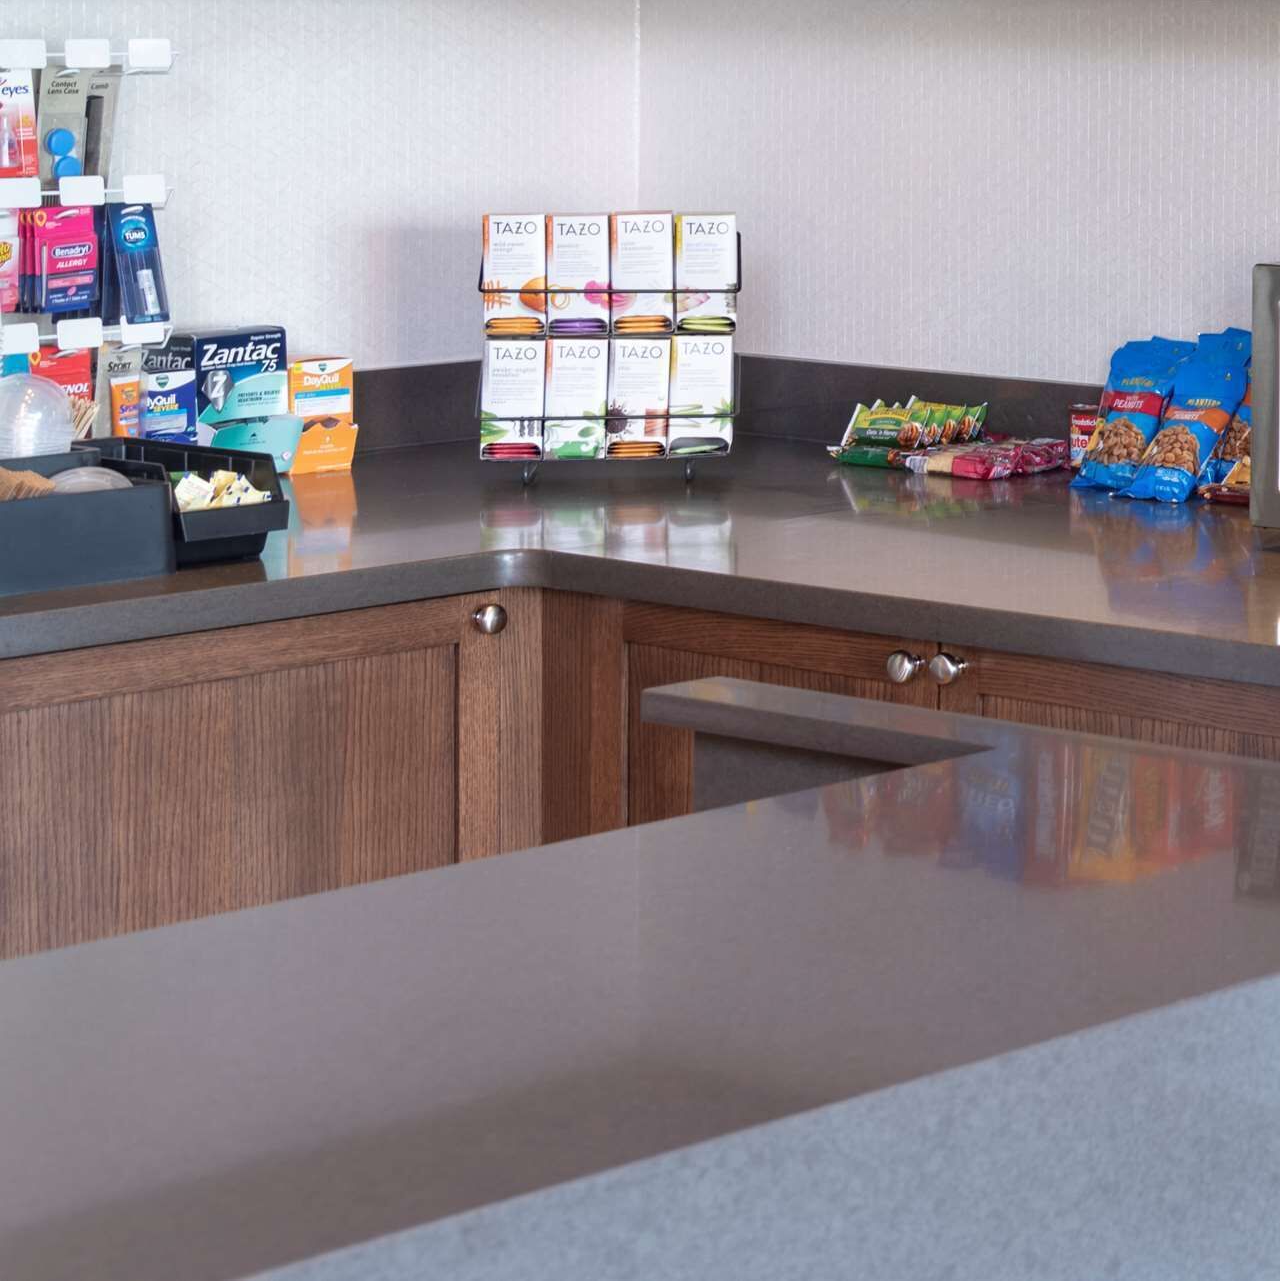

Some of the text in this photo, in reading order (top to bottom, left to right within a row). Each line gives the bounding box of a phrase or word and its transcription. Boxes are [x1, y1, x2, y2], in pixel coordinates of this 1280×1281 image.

[51, 80, 77, 88] Contact
[2, 85, 29, 98] eyes
[493, 221, 537, 235] TAZO
[557, 222, 601, 236] TAZO
[621, 220, 665, 234] TAZO
[686, 221, 730, 235] TAZO
[124, 230, 146, 241] TUMS
[55, 245, 90, 257] Benadryl
[56, 258, 88, 269] ALLERGY
[201, 341, 281, 367] Zantac
[493, 346, 537, 360] TAZO
[557, 345, 601, 360] TAZO
[620, 345, 664, 360] TAZO
[682, 342, 725, 356] TAZO
[141, 347, 191, 370] Zantac
[108, 361, 131, 372] SPORT
[261, 359, 279, 373] 75
[211, 374, 227, 399] Z
[303, 374, 340, 388] DayQuil
[153, 403, 179, 412] SEVERE
[1113, 399, 1144, 409] PEANUTS
